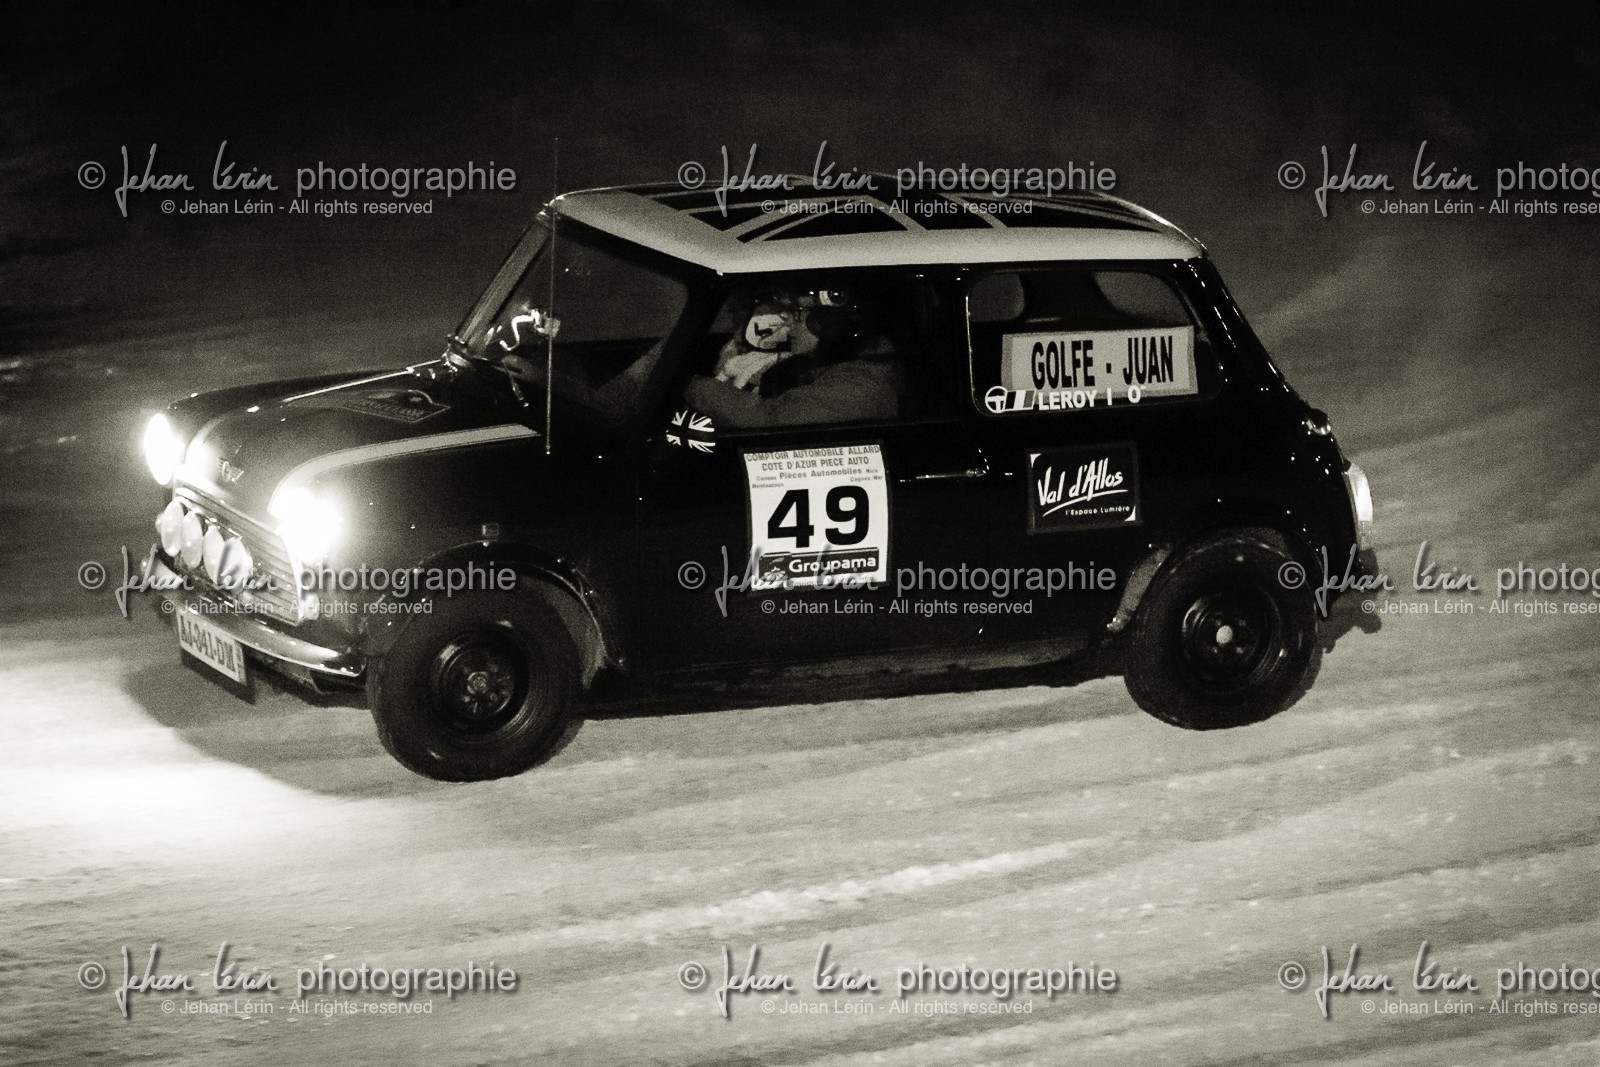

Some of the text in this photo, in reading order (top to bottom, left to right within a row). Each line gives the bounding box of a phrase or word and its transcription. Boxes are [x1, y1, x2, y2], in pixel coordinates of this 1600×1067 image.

[1031, 339, 1096, 390] GOLFE
[1123, 335, 1174, 385] JUAN
[1038, 389, 1098, 411] LEROY
[746, 445, 880, 462] COMPTOIR AUTOMOBILE ALLARD
[761, 456, 869, 471] COTE D'AZUR PIECE AUTO
[779, 471, 807, 479] Pièces
[810, 468, 862, 478] Automobiles
[1037, 457, 1124, 506] Val d'Allos
[767, 485, 870, 549] 49
[1100, 505, 1130, 514] Lumière
[788, 556, 876, 573] Groupama
